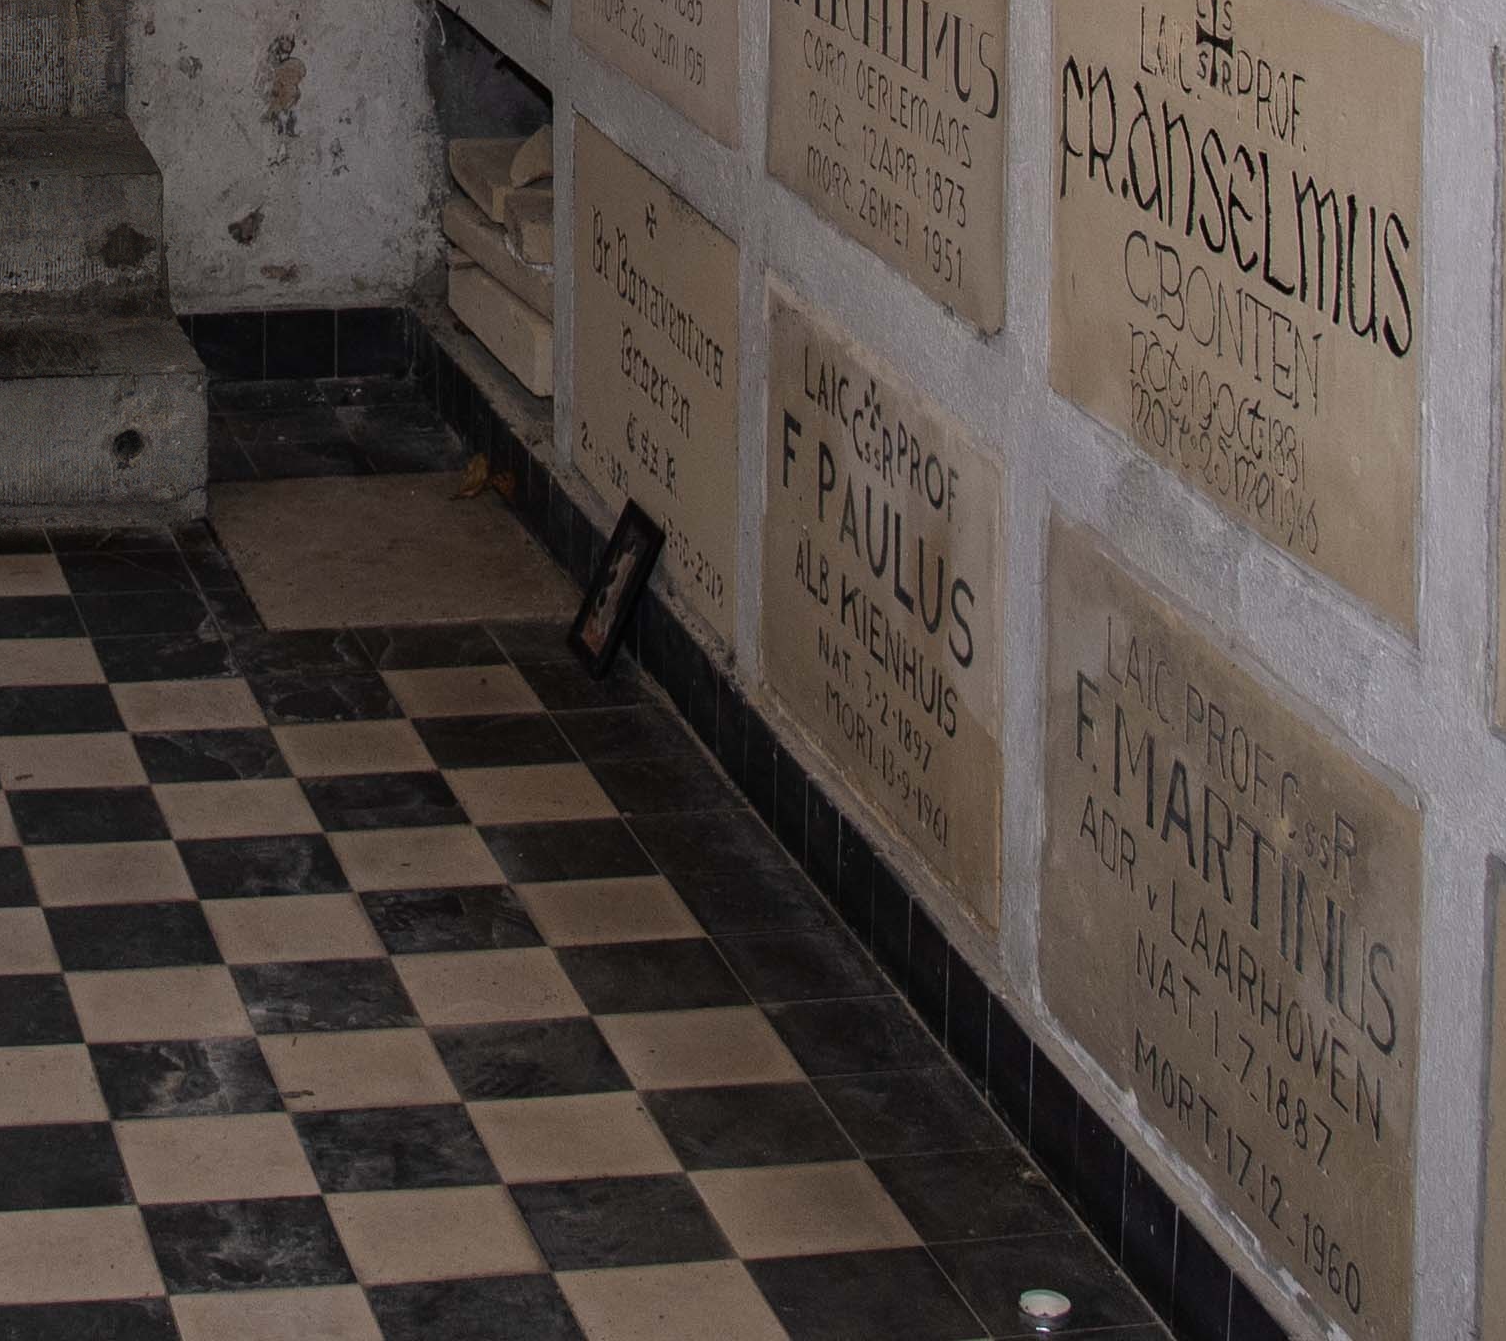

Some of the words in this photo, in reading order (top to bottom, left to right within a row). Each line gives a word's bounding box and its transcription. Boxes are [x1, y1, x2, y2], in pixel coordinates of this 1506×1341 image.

[816, 439, 976, 671] PAULUS
[840, 569, 958, 740] KIENHUIS
[1170, 876, 1383, 1146] LAARHOVEN
